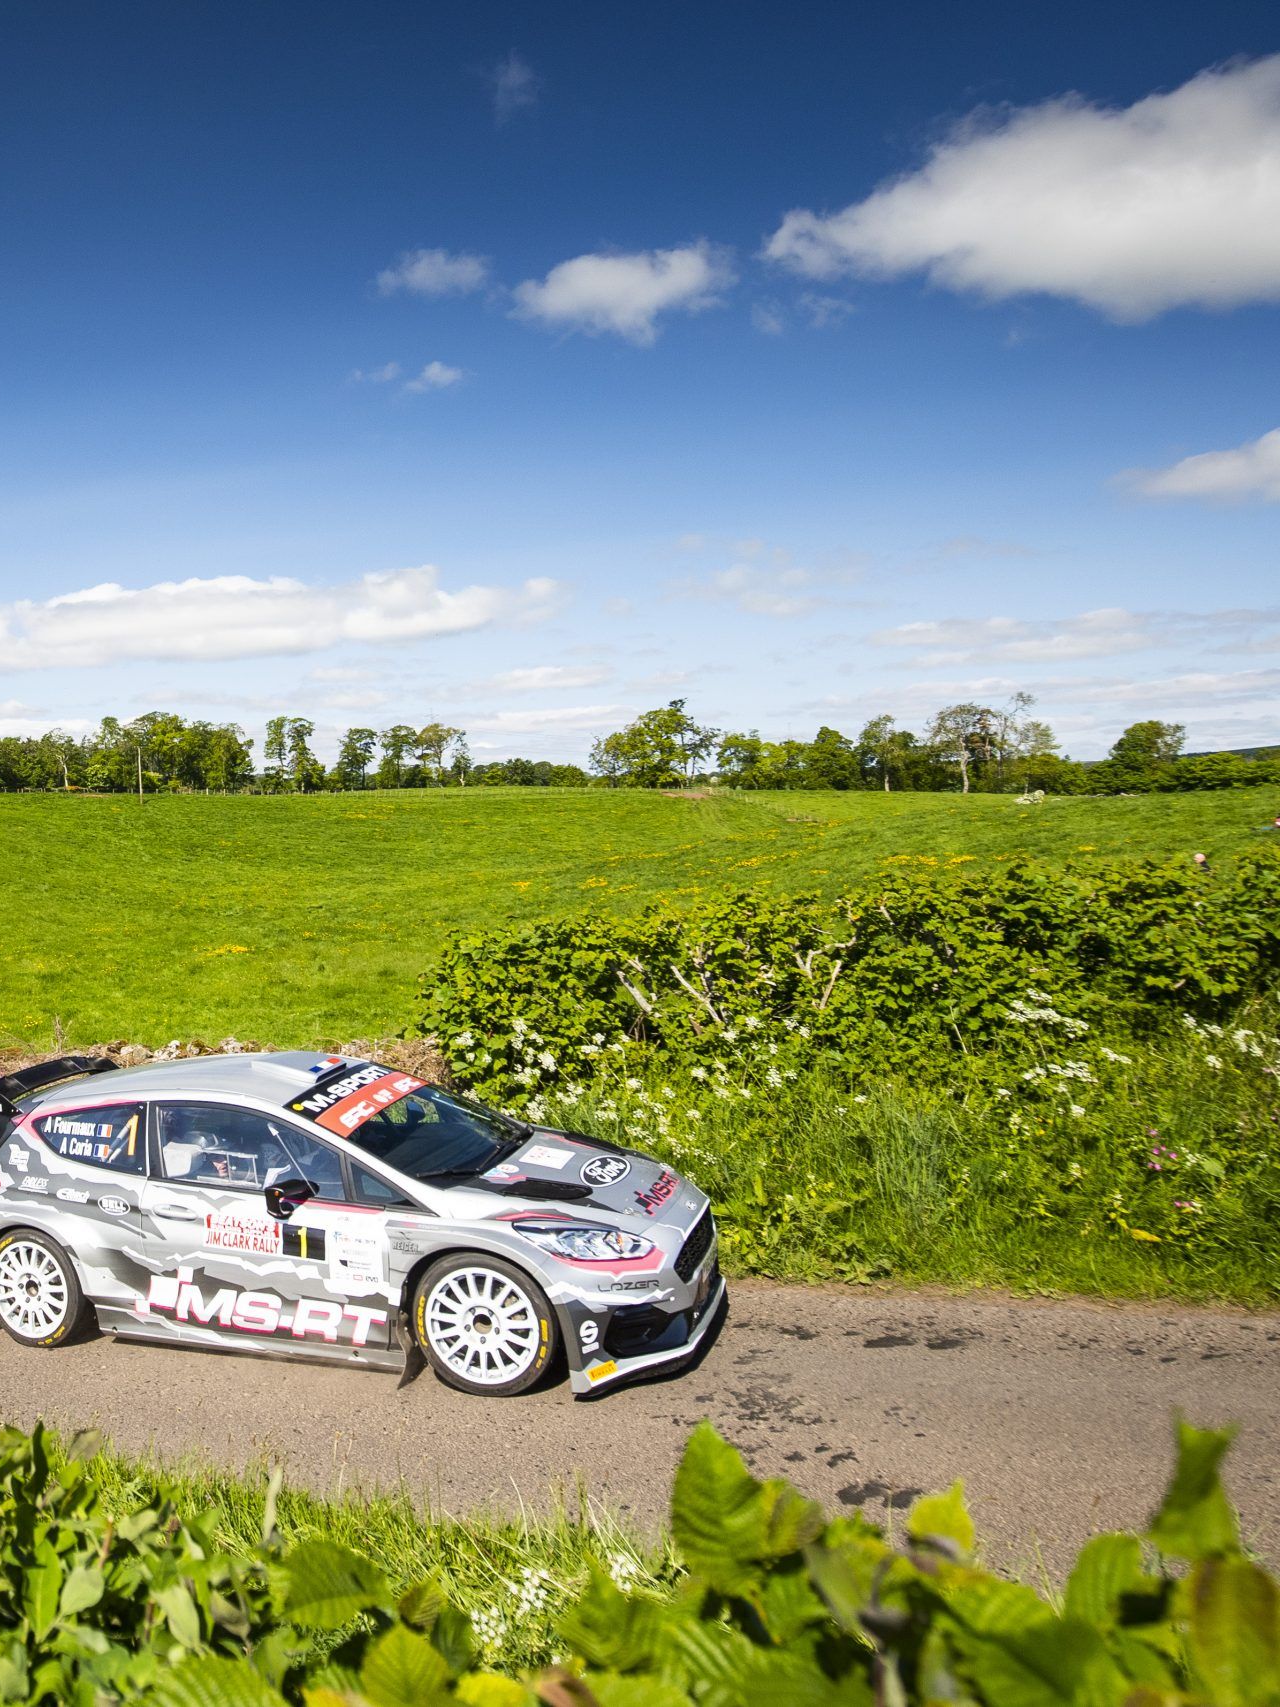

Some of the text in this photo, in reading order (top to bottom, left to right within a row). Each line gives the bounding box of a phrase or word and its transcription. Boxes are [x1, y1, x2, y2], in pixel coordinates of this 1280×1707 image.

[43, 1116, 97, 1137] A Fourmaux
[127, 1114, 139, 1156] 1
[59, 1137, 93, 1157] A Coria
[583, 1158, 625, 1183] Ford
[205, 1231, 221, 1245] JIM
[222, 1233, 250, 1250] CLARK
[252, 1237, 280, 1254] RALLY
[297, 1226, 308, 1259] 1
